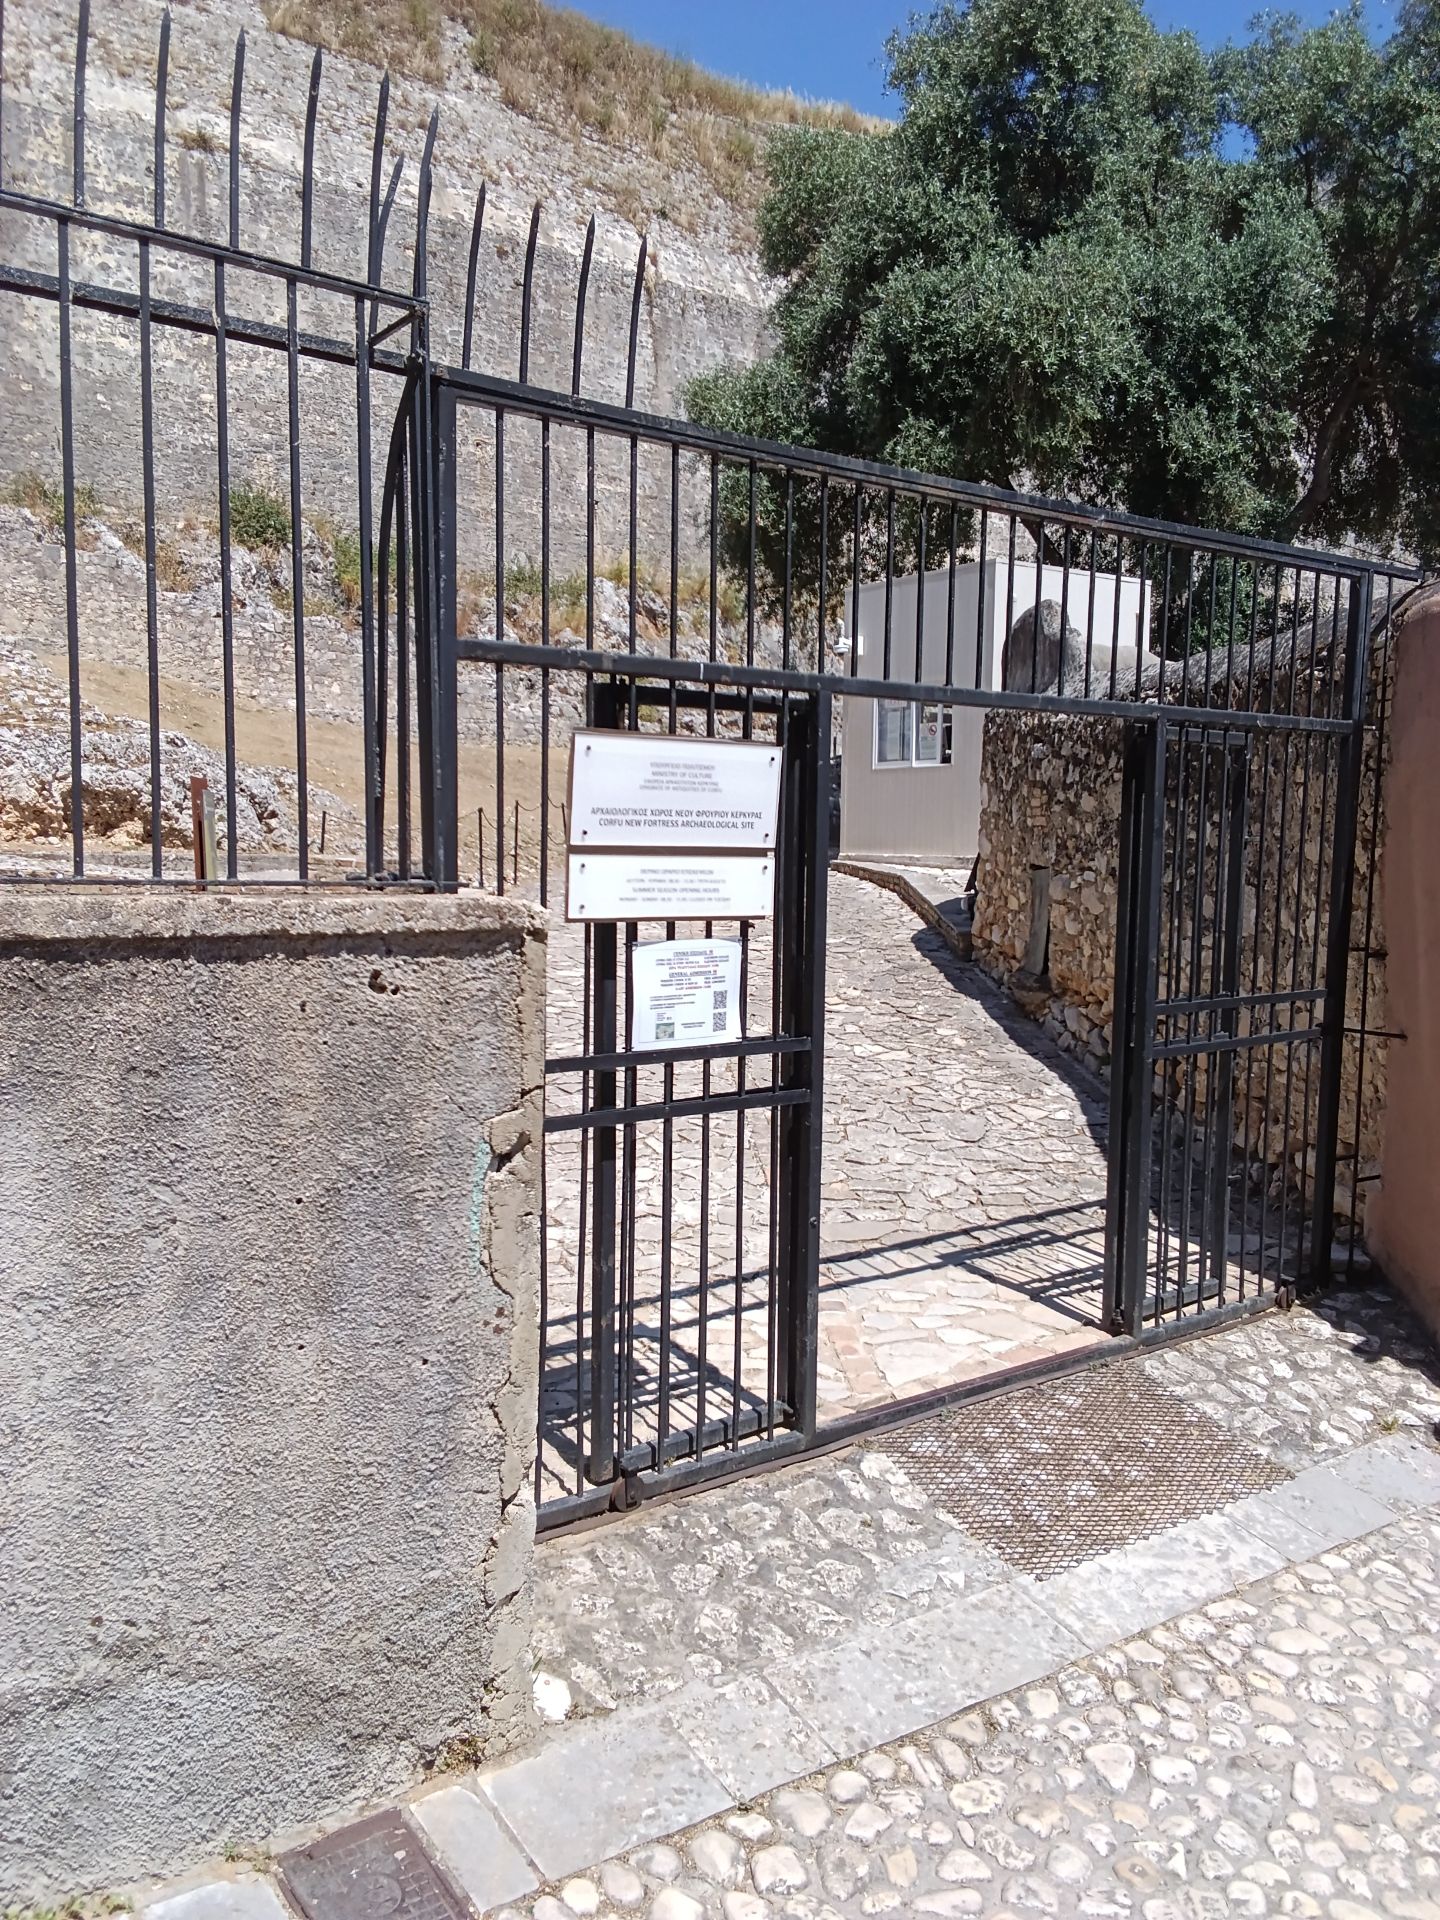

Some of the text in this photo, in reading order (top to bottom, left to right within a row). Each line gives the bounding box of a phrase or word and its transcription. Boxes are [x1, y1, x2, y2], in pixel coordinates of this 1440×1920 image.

[591, 807, 648, 816] ΑΡΧΑΙΟΛΟΓΙΚΟΣ
[696, 810, 729, 819] ΦΡΟΥΡΙΟΥ
[730, 811, 762, 819] ΚΕΡΚΥΡΑΣ
[599, 818, 623, 826] CORFU
[643, 819, 679, 828] FORTRESS
[681, 820, 739, 828] ARCHAEOLOGICAL
